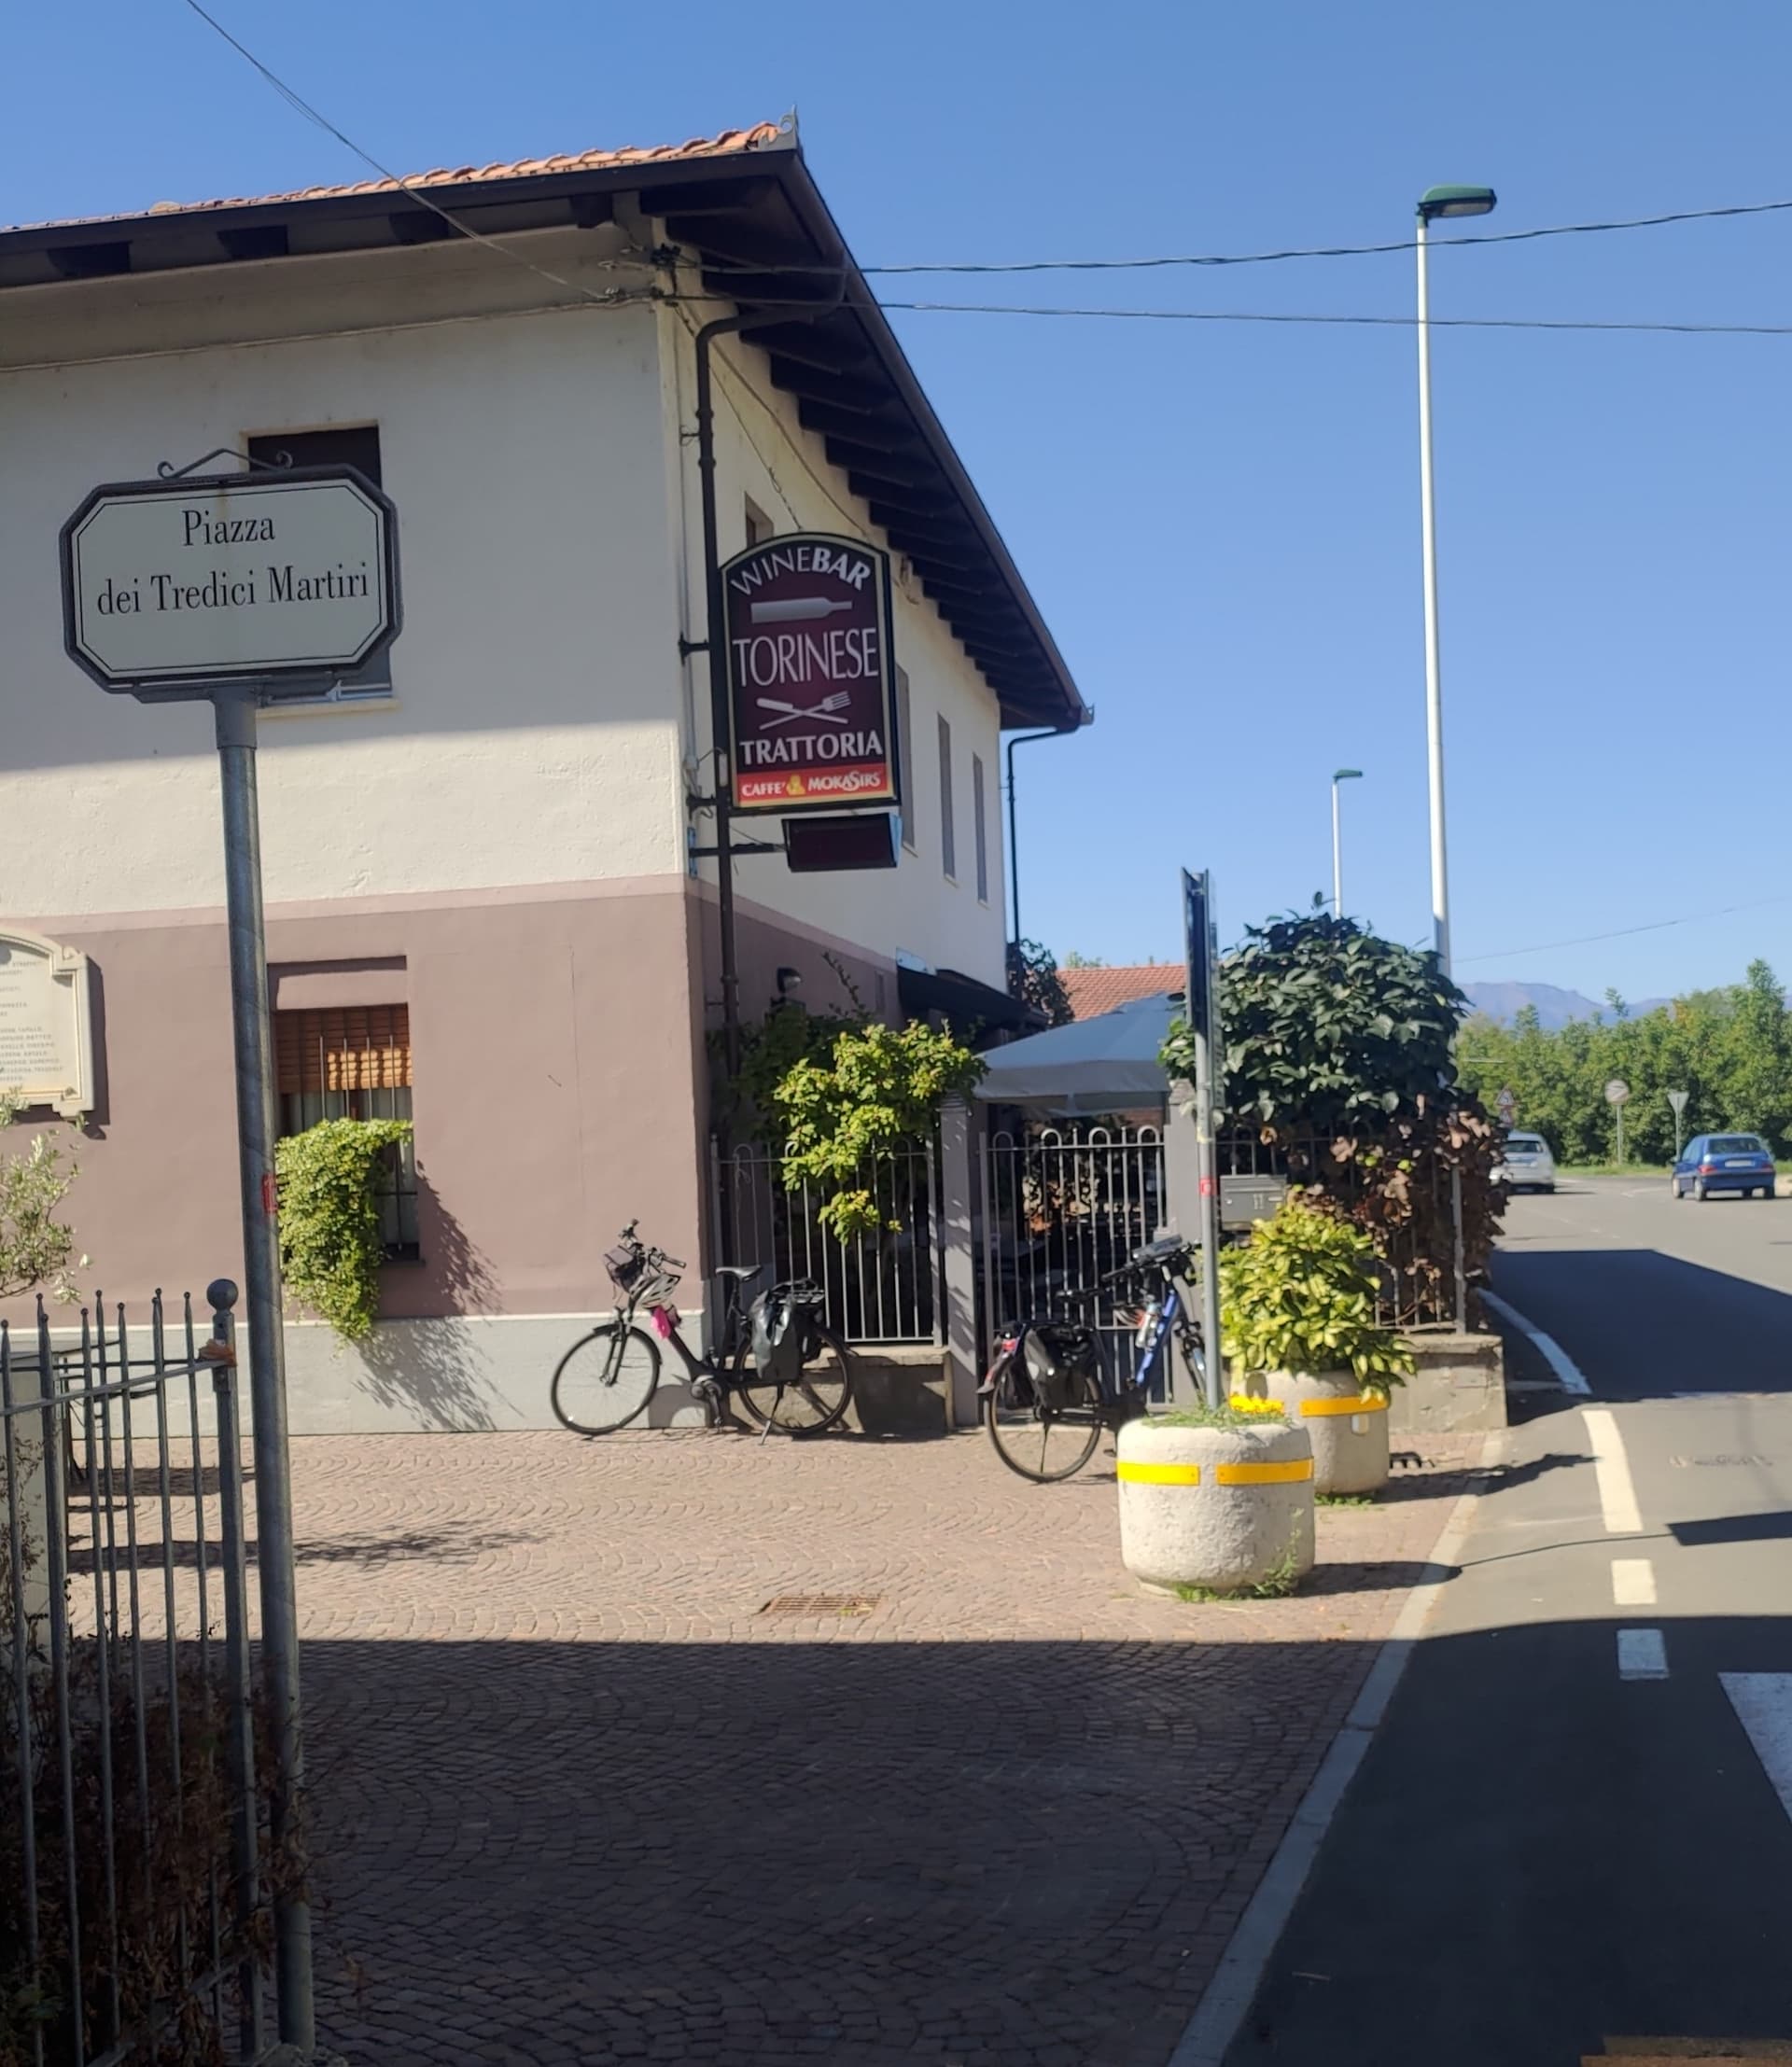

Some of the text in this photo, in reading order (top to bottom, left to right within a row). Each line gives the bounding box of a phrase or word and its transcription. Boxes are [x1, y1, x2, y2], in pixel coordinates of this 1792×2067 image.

[181, 510, 276, 547] Piazza
[97, 561, 370, 616] dei Tredici Martiri
[732, 626, 880, 688] TORINESE
[739, 730, 884, 765] TRATTORIA
